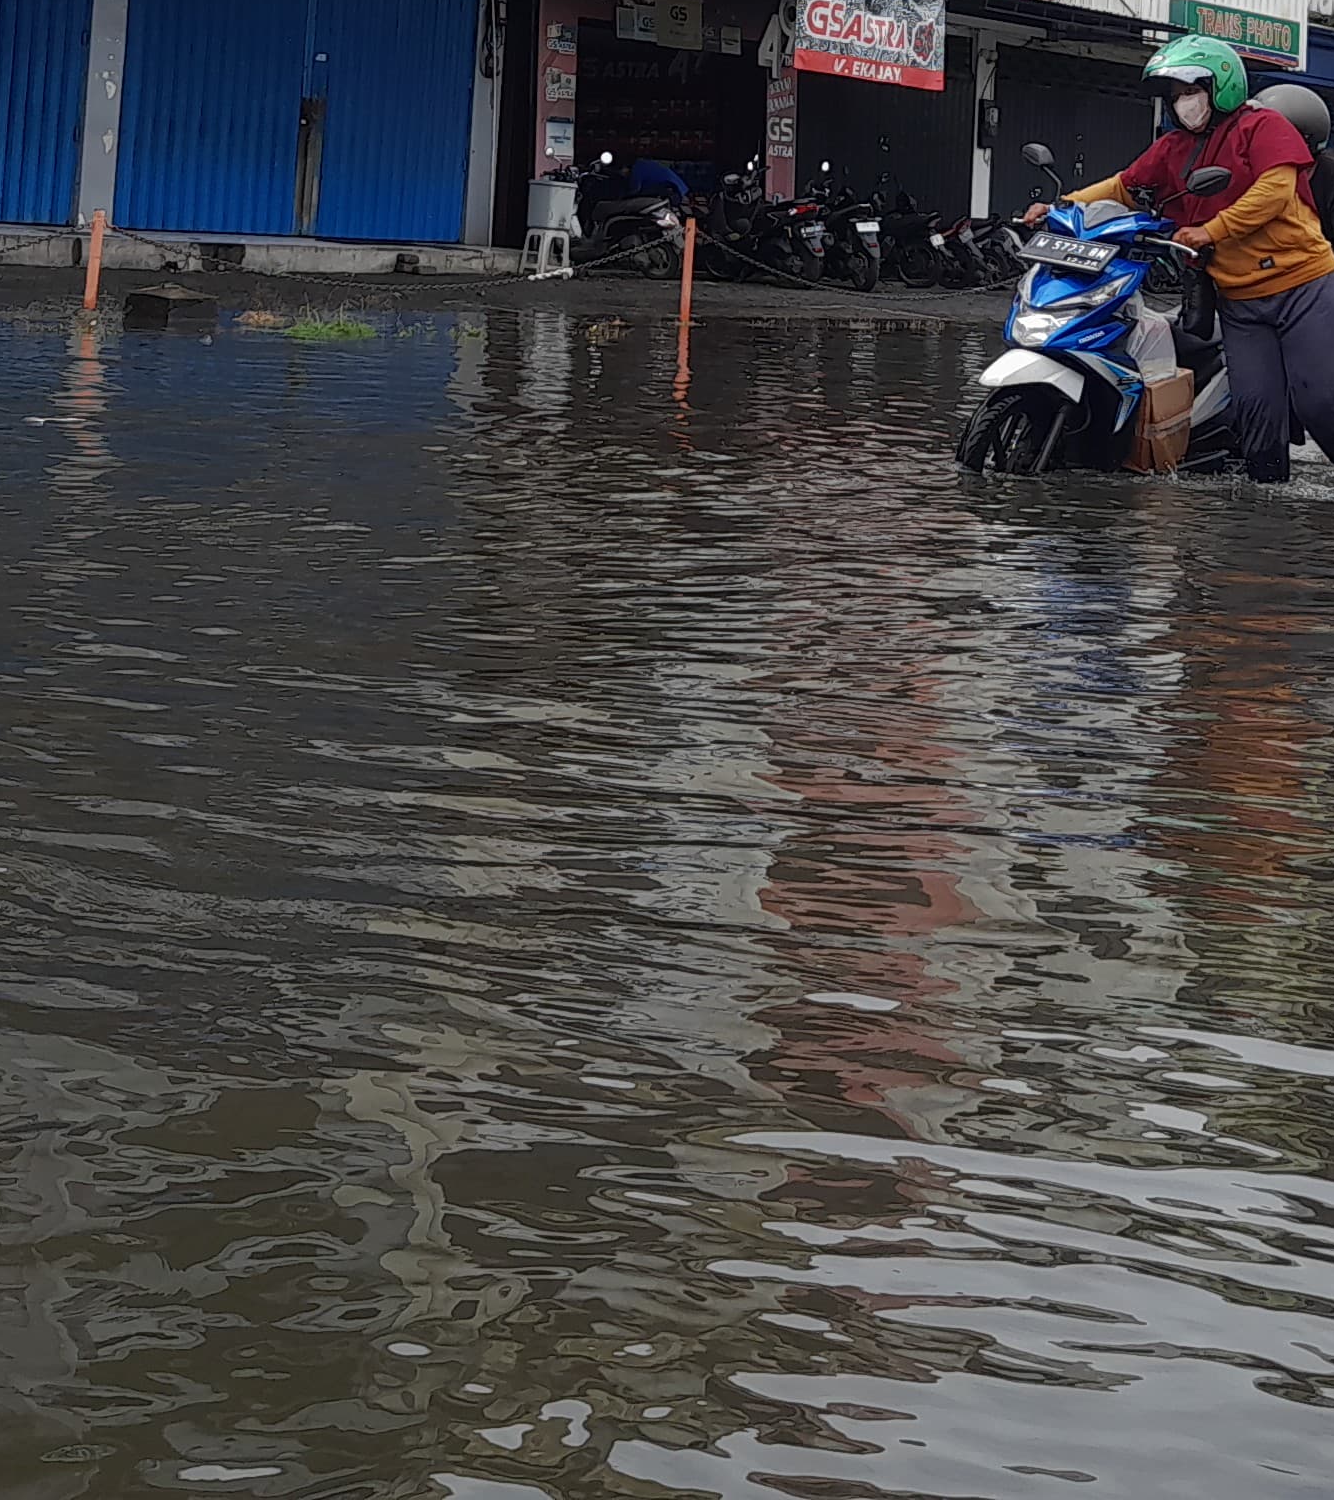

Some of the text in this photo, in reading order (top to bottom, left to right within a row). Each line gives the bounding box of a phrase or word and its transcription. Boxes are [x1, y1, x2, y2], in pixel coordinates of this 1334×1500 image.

[669, 5, 688, 22] GS
[1247, 16, 1291, 52] PHOTO
[768, 117, 793, 142] GS
[768, 145, 793, 158] ASTRA
